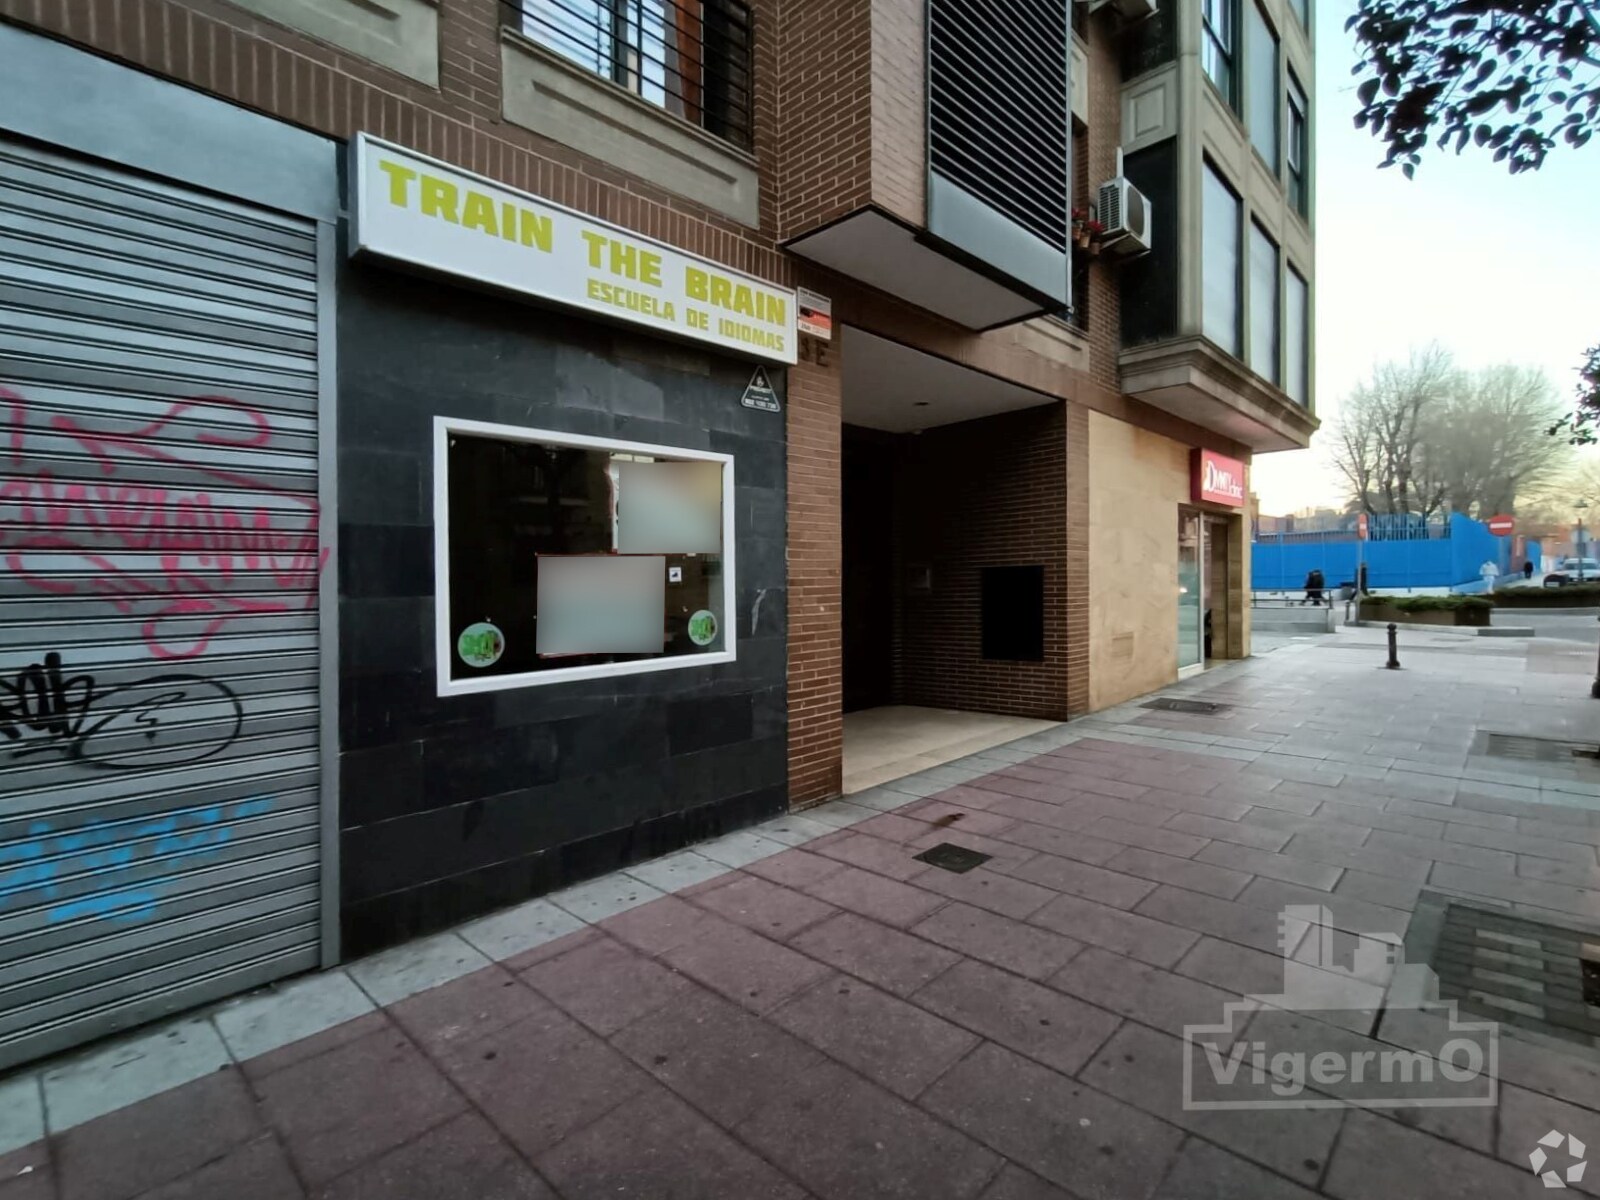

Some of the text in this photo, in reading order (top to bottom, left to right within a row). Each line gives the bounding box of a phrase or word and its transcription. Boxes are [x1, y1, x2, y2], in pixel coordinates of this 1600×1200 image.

[380, 160, 786, 326] TRAIN THE BRAIN
[587, 279, 784, 352] ESCUELA DE IDIOMAS
